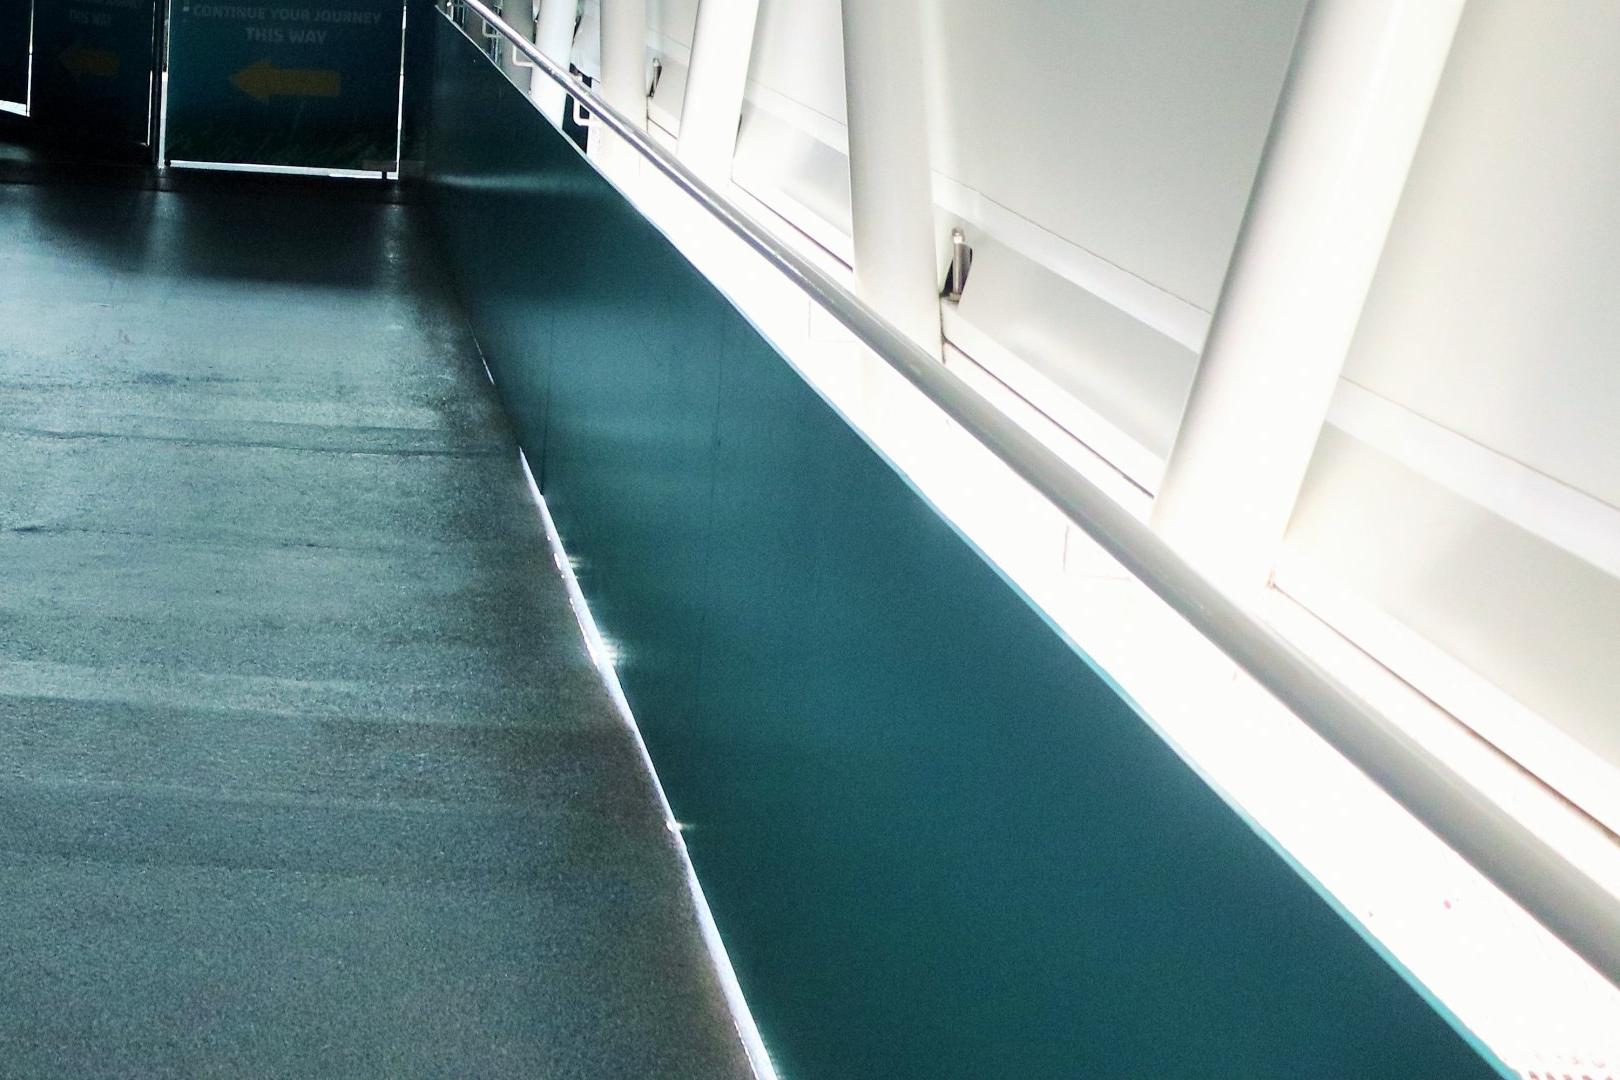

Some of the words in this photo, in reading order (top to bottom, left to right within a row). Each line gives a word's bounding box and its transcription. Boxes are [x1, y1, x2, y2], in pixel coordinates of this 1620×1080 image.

[192, 4, 266, 20] CONTINUE
[269, 7, 310, 21] YOUR
[313, 9, 383, 24] JOURNEY
[246, 27, 284, 42] THIS
[289, 30, 328, 44] WAY
